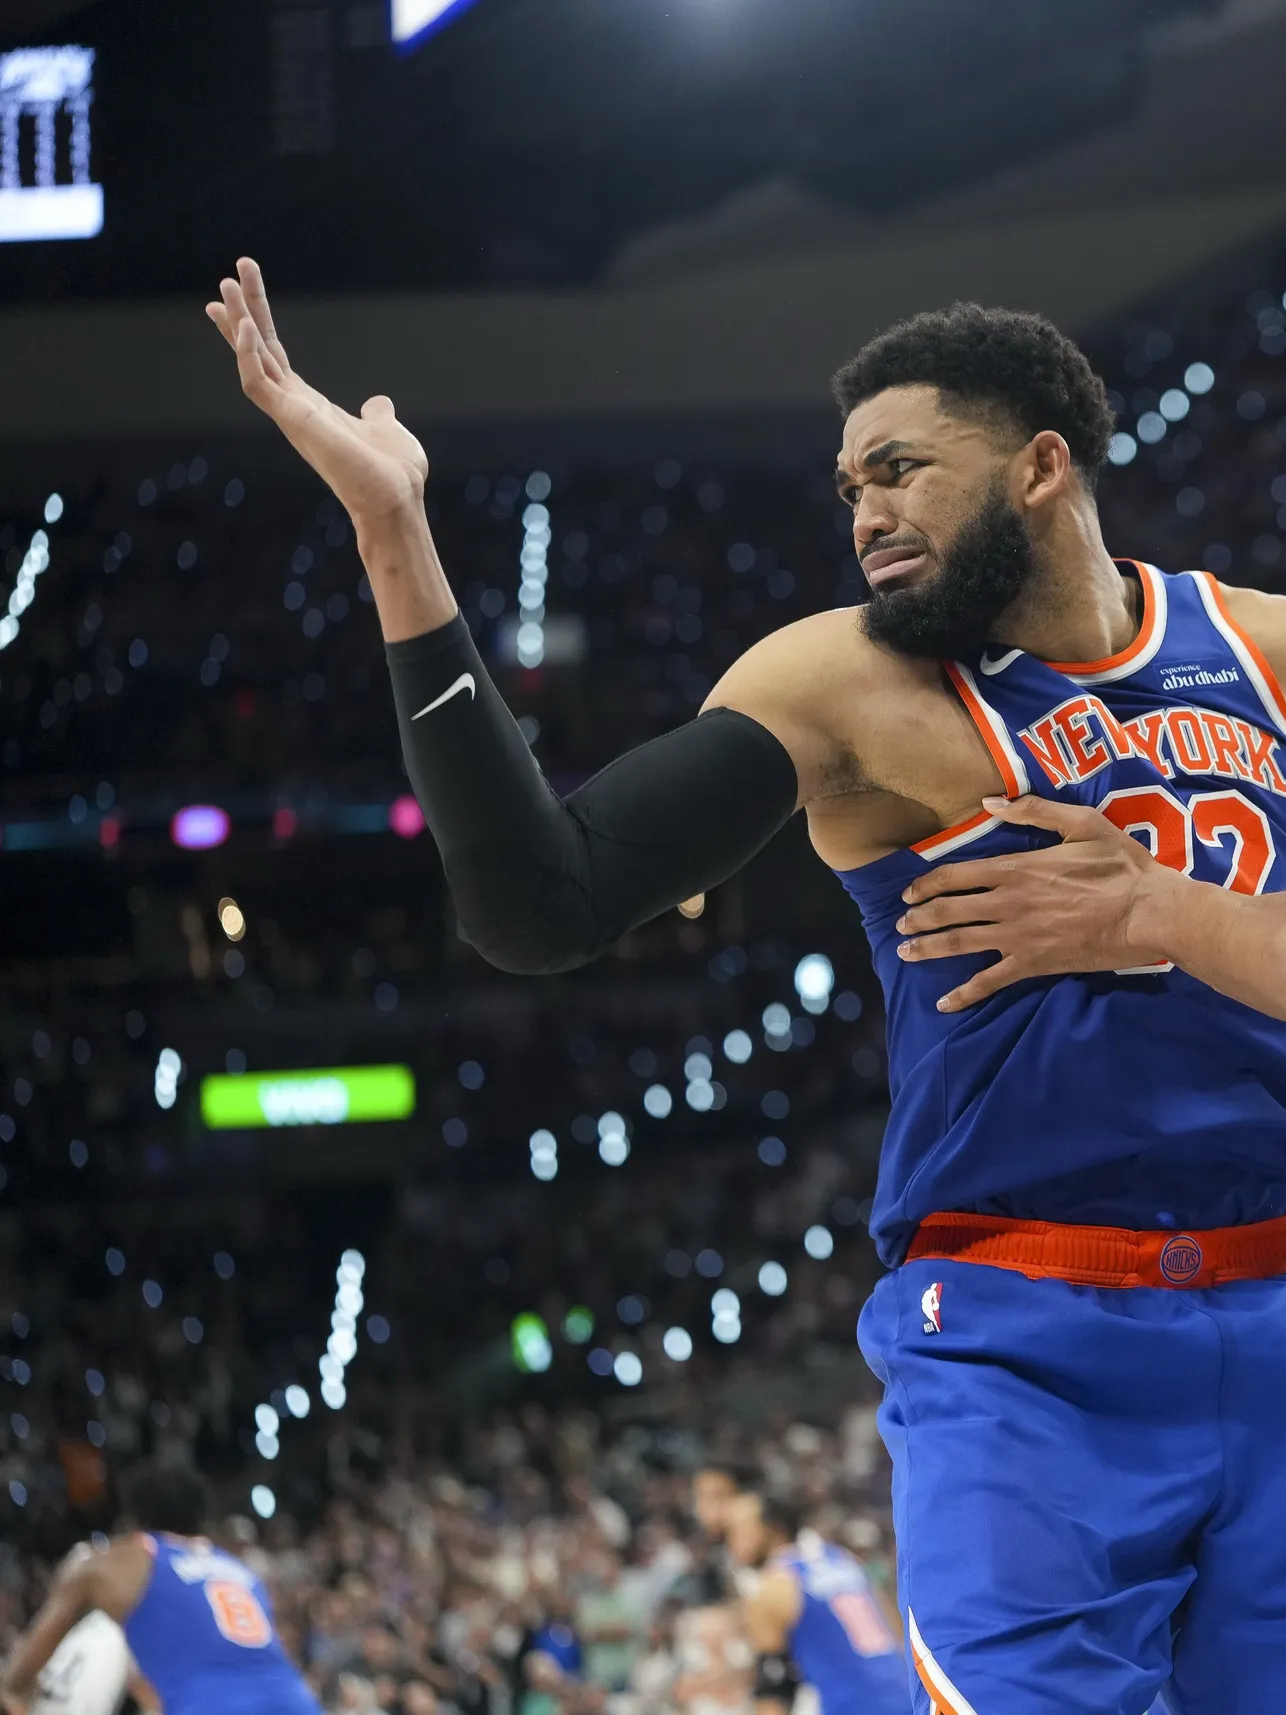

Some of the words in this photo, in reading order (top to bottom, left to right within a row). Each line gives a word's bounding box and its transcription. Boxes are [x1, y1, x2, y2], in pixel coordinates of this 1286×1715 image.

[1159, 664, 1201, 676] experience
[1162, 674, 1195, 691] abu
[1194, 666, 1240, 685] dhabi
[923, 1321, 935, 1334] NBA
